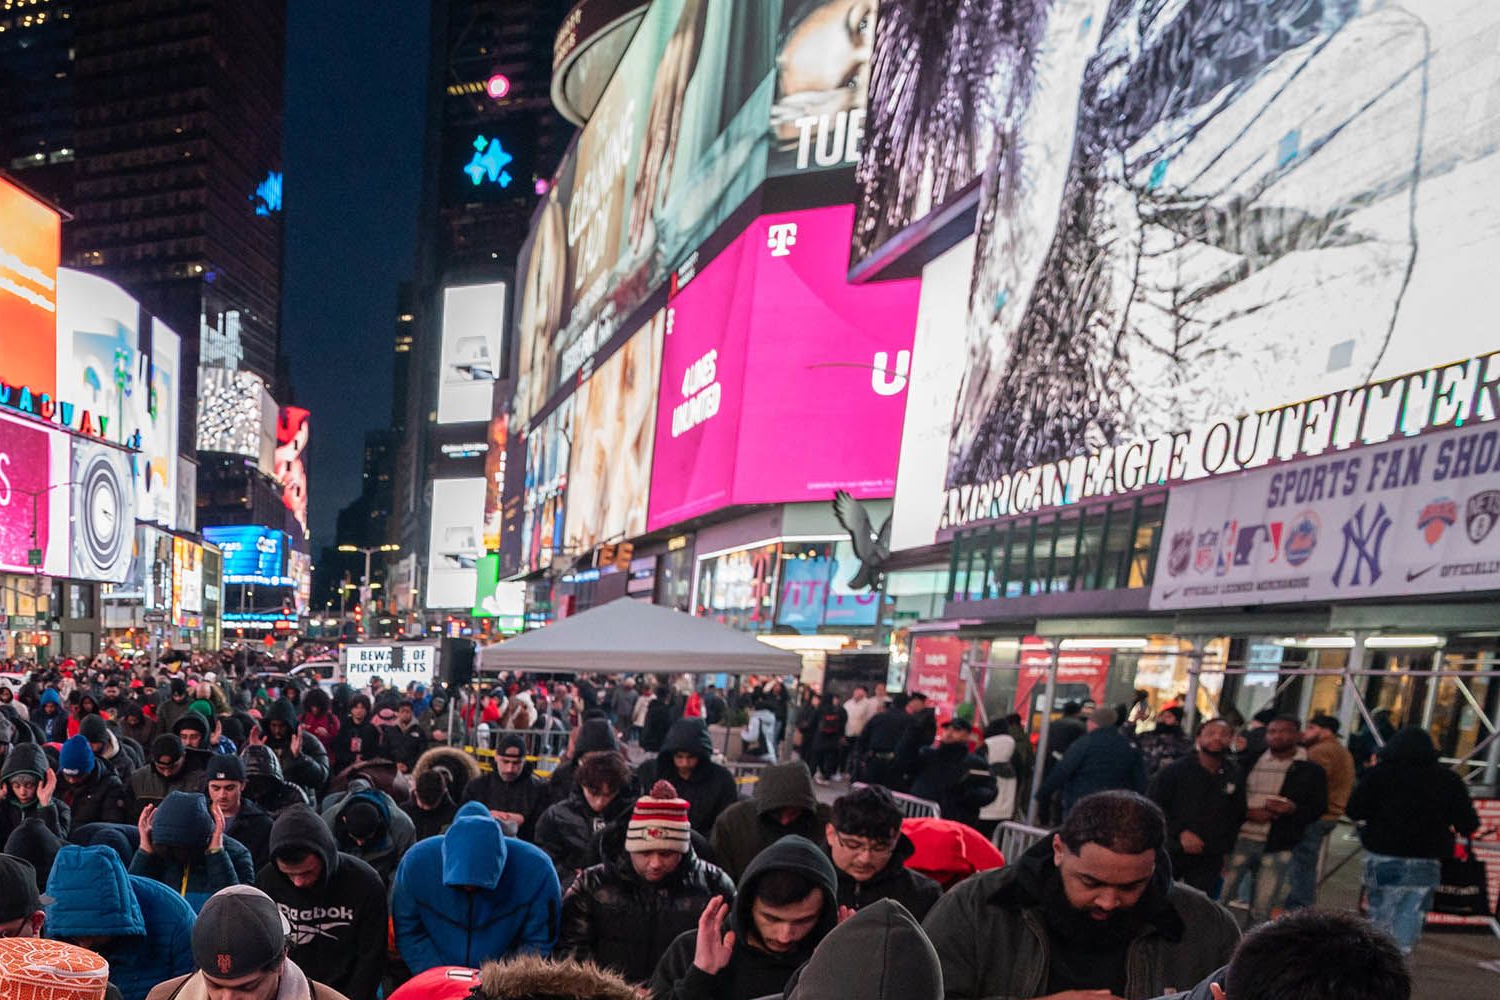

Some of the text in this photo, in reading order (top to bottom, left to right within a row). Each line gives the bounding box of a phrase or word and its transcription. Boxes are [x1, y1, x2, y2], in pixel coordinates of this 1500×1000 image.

[938, 455, 1087, 531] AMERICAN
[1083, 430, 1192, 496] EAGLE
[1268, 430, 1500, 507] SPORTS FAN SHO
[413, 649, 426, 660] OF
[276, 902, 353, 920] Reebok
